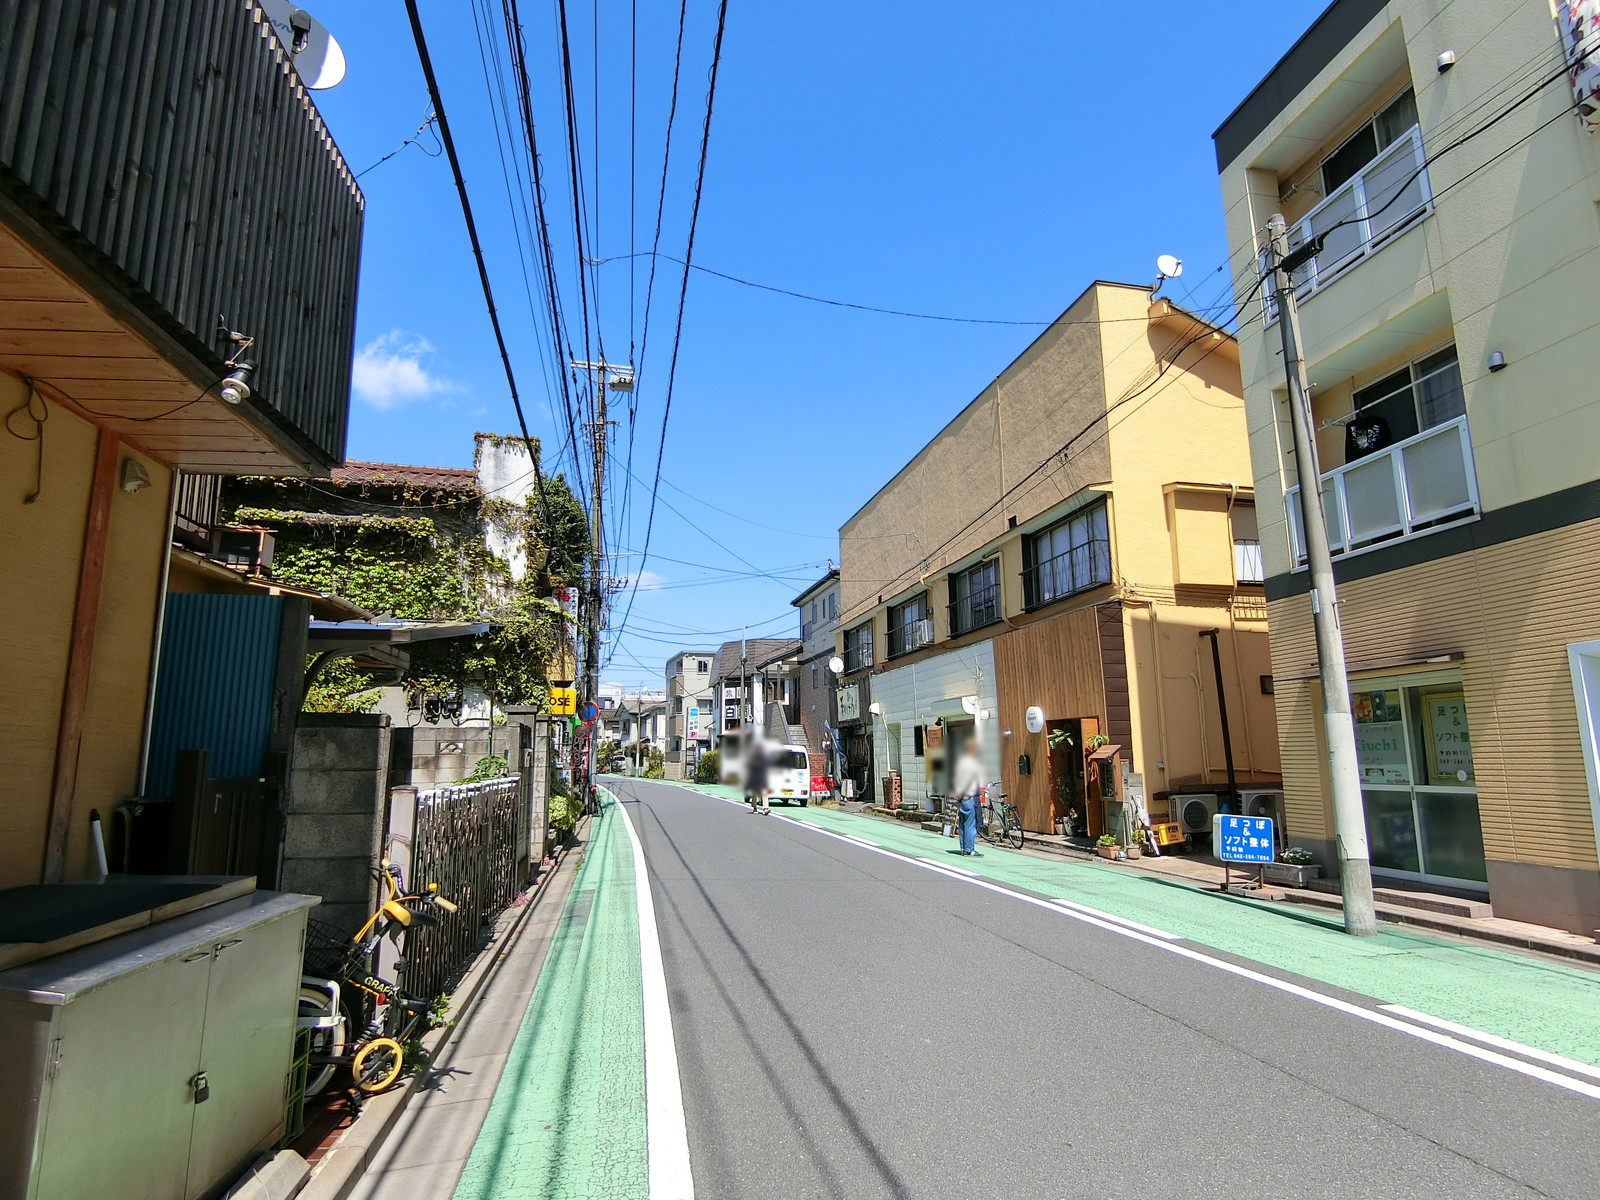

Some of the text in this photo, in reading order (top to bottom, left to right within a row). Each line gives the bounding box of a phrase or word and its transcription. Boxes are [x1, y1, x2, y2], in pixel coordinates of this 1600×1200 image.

[1438, 704, 1466, 716] 足つ
[1453, 717, 1461, 726] &
[1358, 739, 1397, 751] iuchi
[1243, 827, 1251, 836] &
